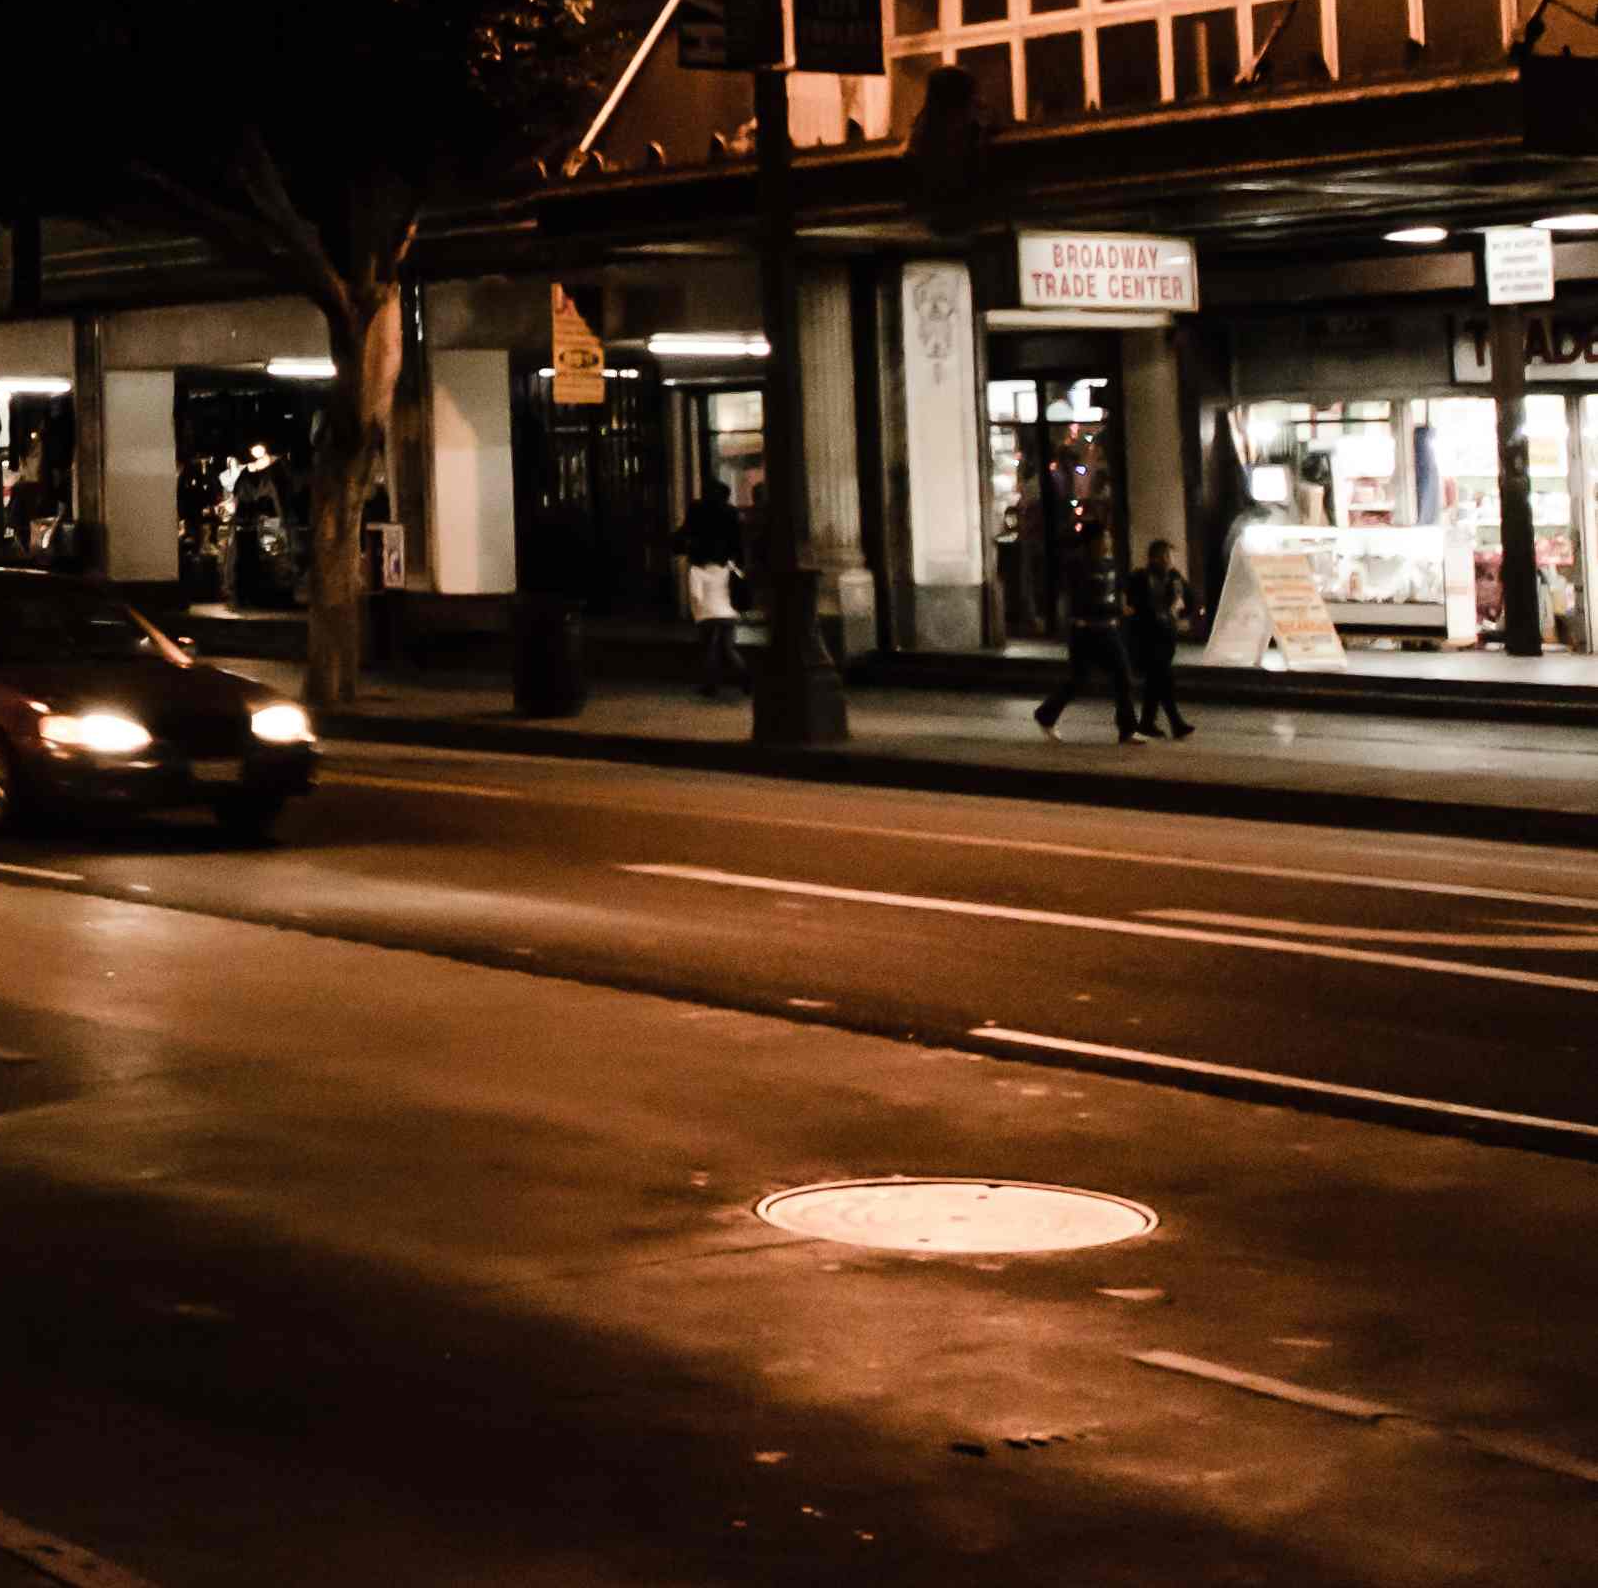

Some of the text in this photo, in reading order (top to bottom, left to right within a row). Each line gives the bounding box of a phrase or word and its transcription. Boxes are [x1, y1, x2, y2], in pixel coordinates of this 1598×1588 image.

[1053, 243, 1158, 270] BROADWAY
[1031, 272, 1184, 300] TRADE CENTER
